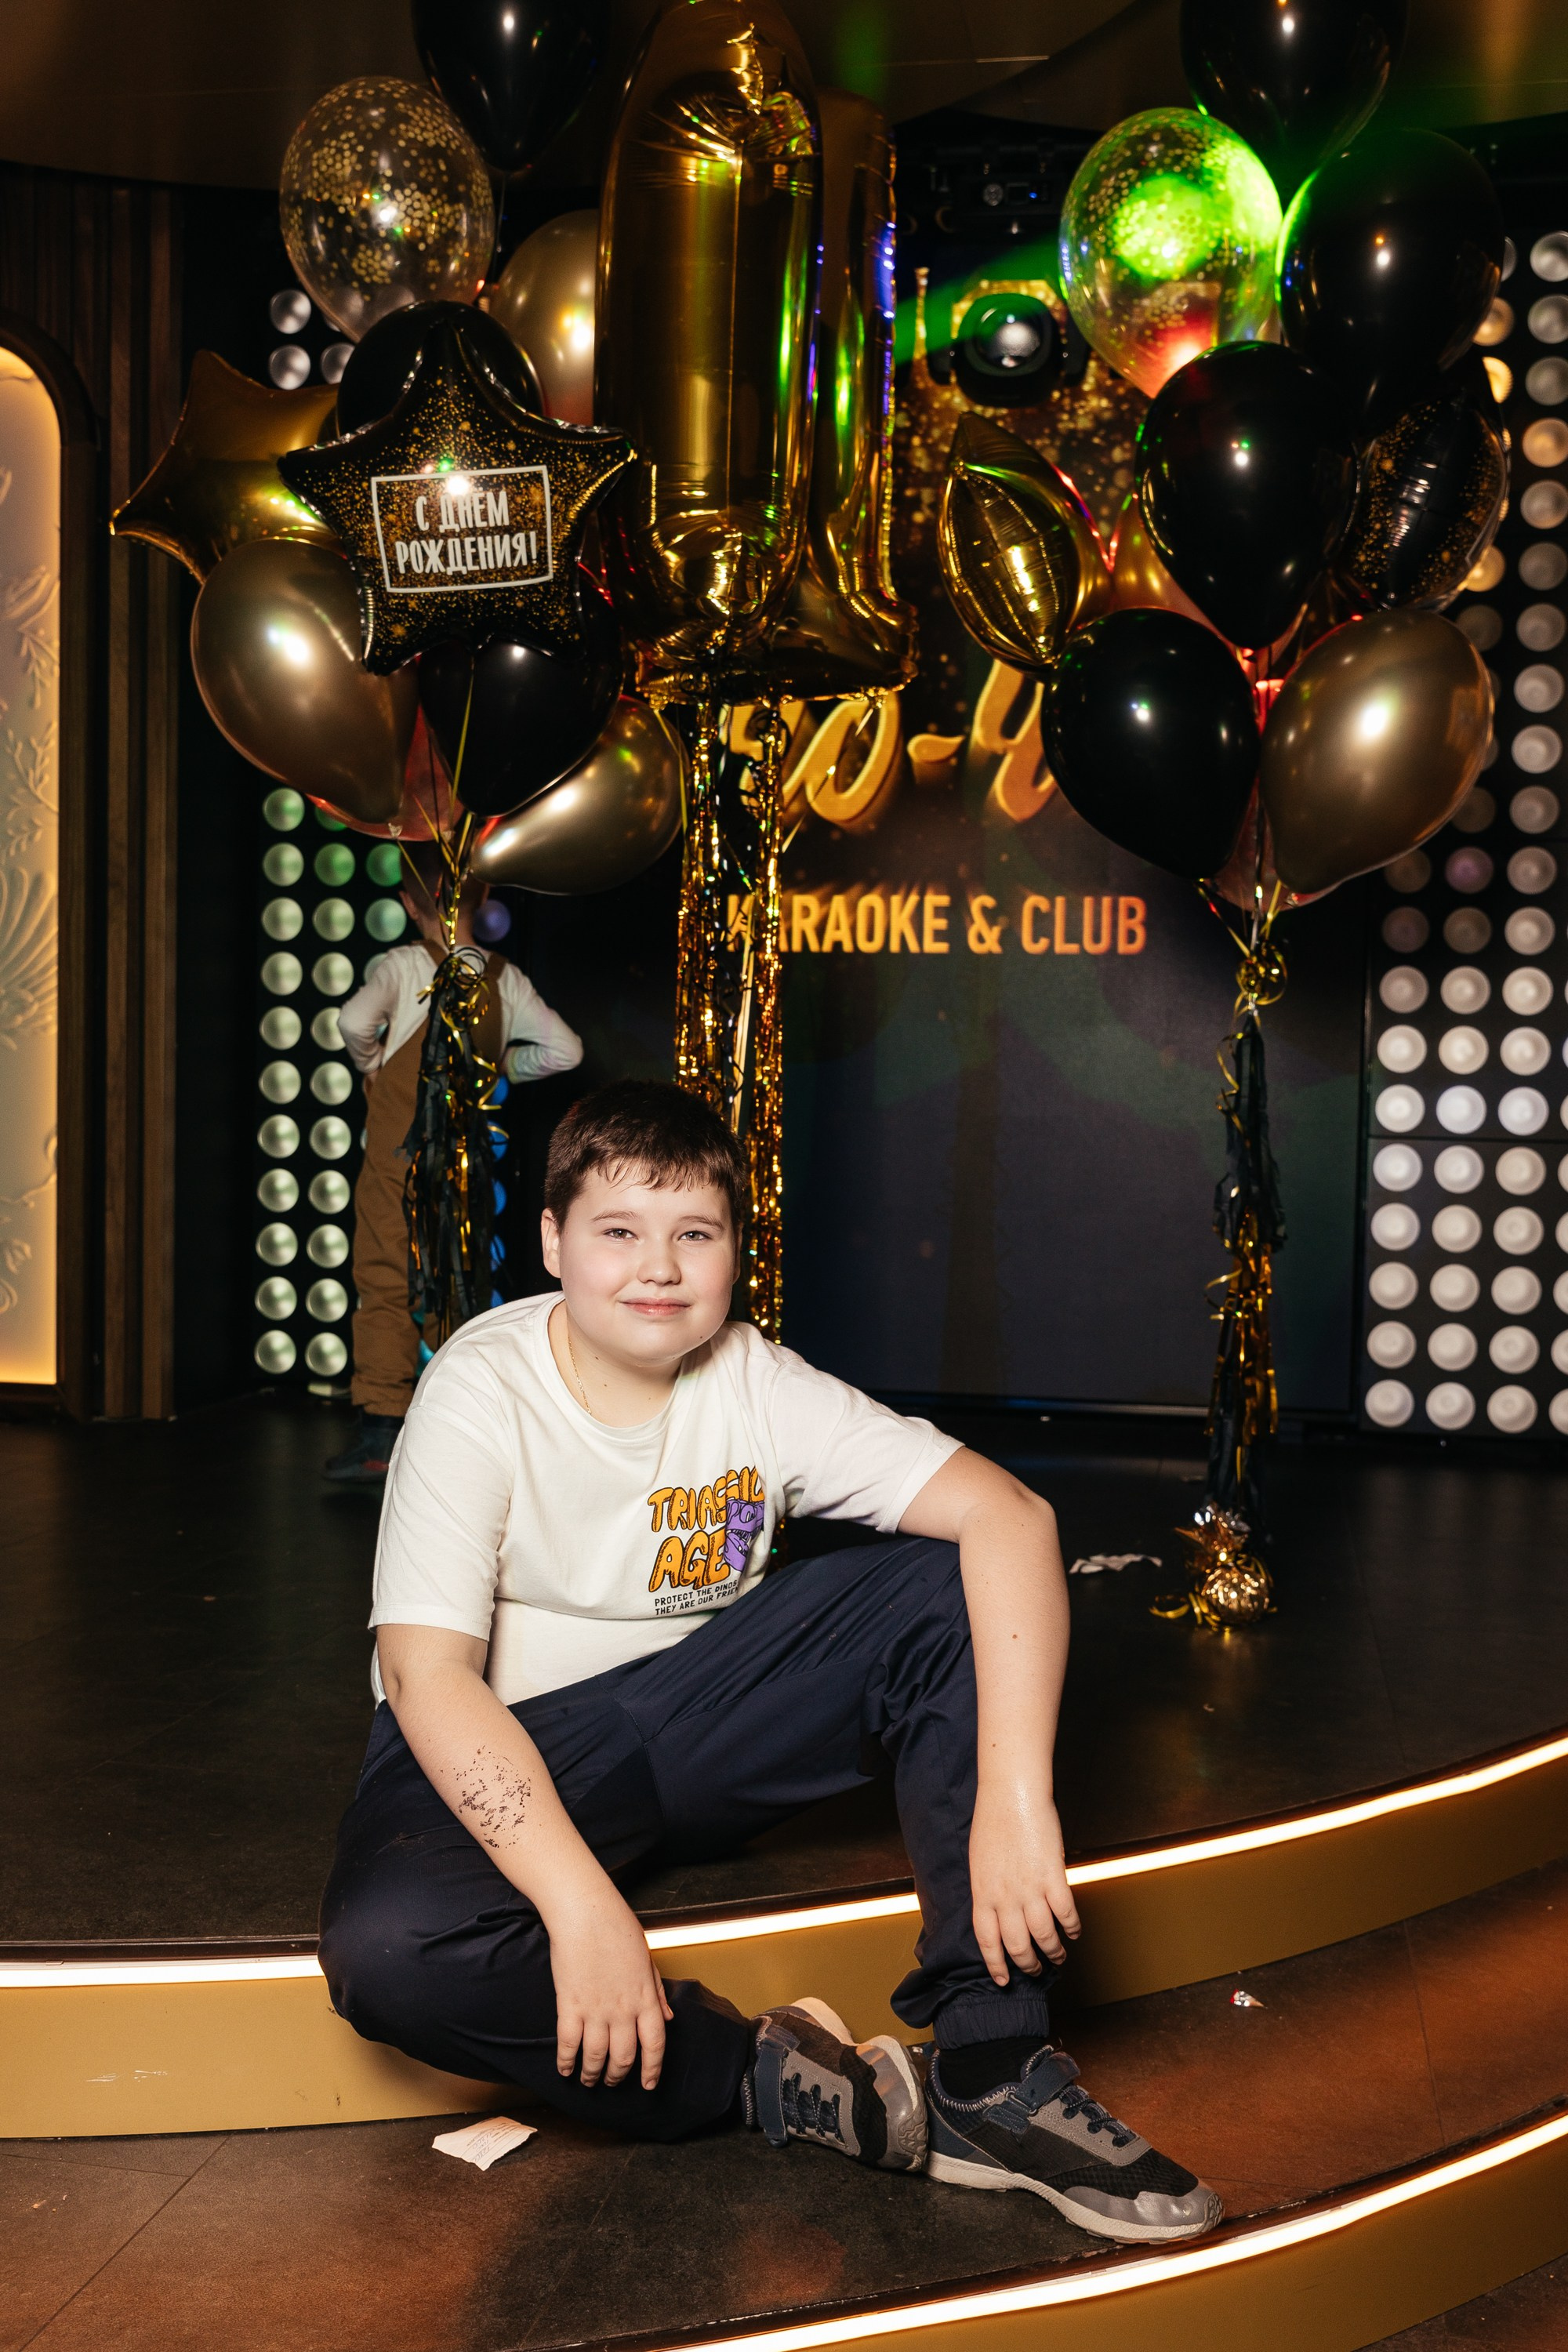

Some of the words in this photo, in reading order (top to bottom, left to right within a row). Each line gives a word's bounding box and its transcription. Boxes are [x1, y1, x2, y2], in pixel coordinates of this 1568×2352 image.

[416, 495, 430, 531] С
[439, 490, 510, 533] ДНЕМ
[395, 530, 537, 575] РОЖДЕНИЯ!
[966, 895, 1004, 952] &
[1022, 895, 1148, 953] CLUB
[648, 1524, 730, 1592] AGE
[655, 1592, 693, 1606] PROTECT
[697, 1588, 712, 1596] THE
[655, 1602, 677, 1616] THEY
[679, 1598, 695, 1610] ARE
[698, 1595, 713, 1605] OUR
